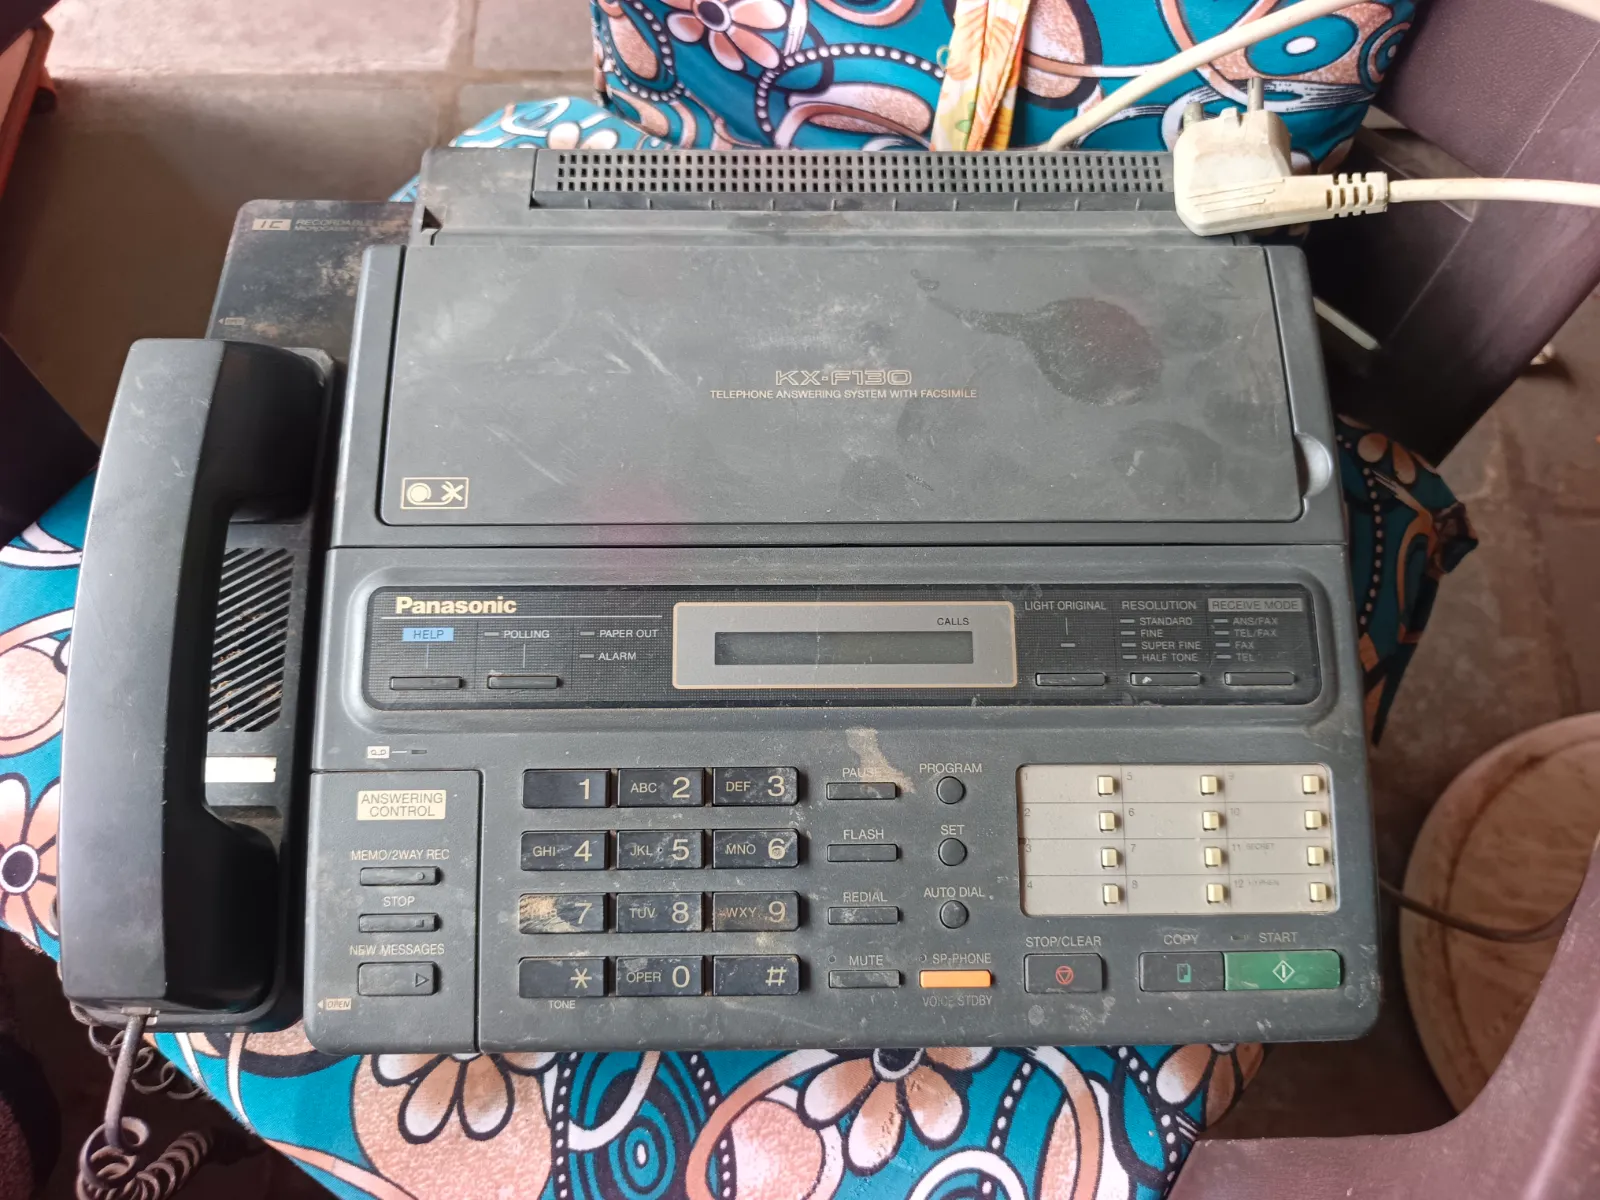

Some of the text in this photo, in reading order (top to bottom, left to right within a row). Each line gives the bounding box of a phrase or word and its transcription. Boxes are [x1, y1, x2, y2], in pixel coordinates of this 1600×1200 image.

[775, 370, 912, 386] KX-F130
[710, 389, 978, 400] TELEPHONE ANSWERING SYSTEM WITH FACSIMILE
[396, 596, 517, 614] Panasonic
[1024, 600, 1107, 612] LIGHT ORIGINAL
[1121, 600, 1197, 611] RESOLUTION
[1212, 600, 1299, 610] RECEIVE MODE
[937, 616, 970, 626] CALLS
[1139, 617, 1193, 626] STANDARD
[1232, 617, 1278, 626] ANS/FAX
[413, 629, 445, 640] HELP
[503, 629, 550, 639] POLLING
[599, 629, 659, 639] PAPER OUT
[1140, 629, 1163, 638] FINE
[1234, 629, 1278, 638] TEL/FAX
[1141, 641, 1201, 650] SUPER FINE
[1235, 641, 1254, 650] FAX
[598, 652, 637, 661] ALARM
[1142, 653, 1199, 662] HALF TONE
[1236, 653, 1255, 662] TEL
[919, 763, 983, 774] PROGRAM
[578, 778, 591, 800] 1
[630, 777, 691, 799] ABC 2
[725, 775, 786, 797] DEF 3
[360, 792, 444, 805] ANSWERING
[369, 806, 436, 818] CONTROL
[1024, 807, 1031, 817] 2
[844, 829, 884, 840] FLASH
[940, 824, 965, 835] SET
[351, 848, 450, 861] MEMO/2WAY REC
[532, 840, 592, 862] GHI 4
[630, 838, 690, 861] JKL 5
[725, 838, 786, 860] MNO 6
[843, 891, 888, 902] REDIAL
[924, 887, 985, 898] AUTO DIAL
[383, 896, 415, 907] STOP
[574, 902, 593, 924] 7
[629, 901, 690, 924] TUV 8
[727, 901, 786, 923] WXY 9
[1025, 936, 1101, 948] STOP/CLEAR
[1163, 934, 1199, 946] COPY
[1258, 931, 1299, 943] START
[350, 944, 445, 956] NEW MESSAGES
[849, 955, 884, 966] MUTE
[932, 953, 992, 964] SP-PHONE
[626, 972, 662, 983] OPER
[765, 966, 787, 987] #
[327, 1000, 350, 1009] OPEN
[549, 1000, 576, 1010] TONE
[922, 995, 993, 1006] VOICE STDBY
